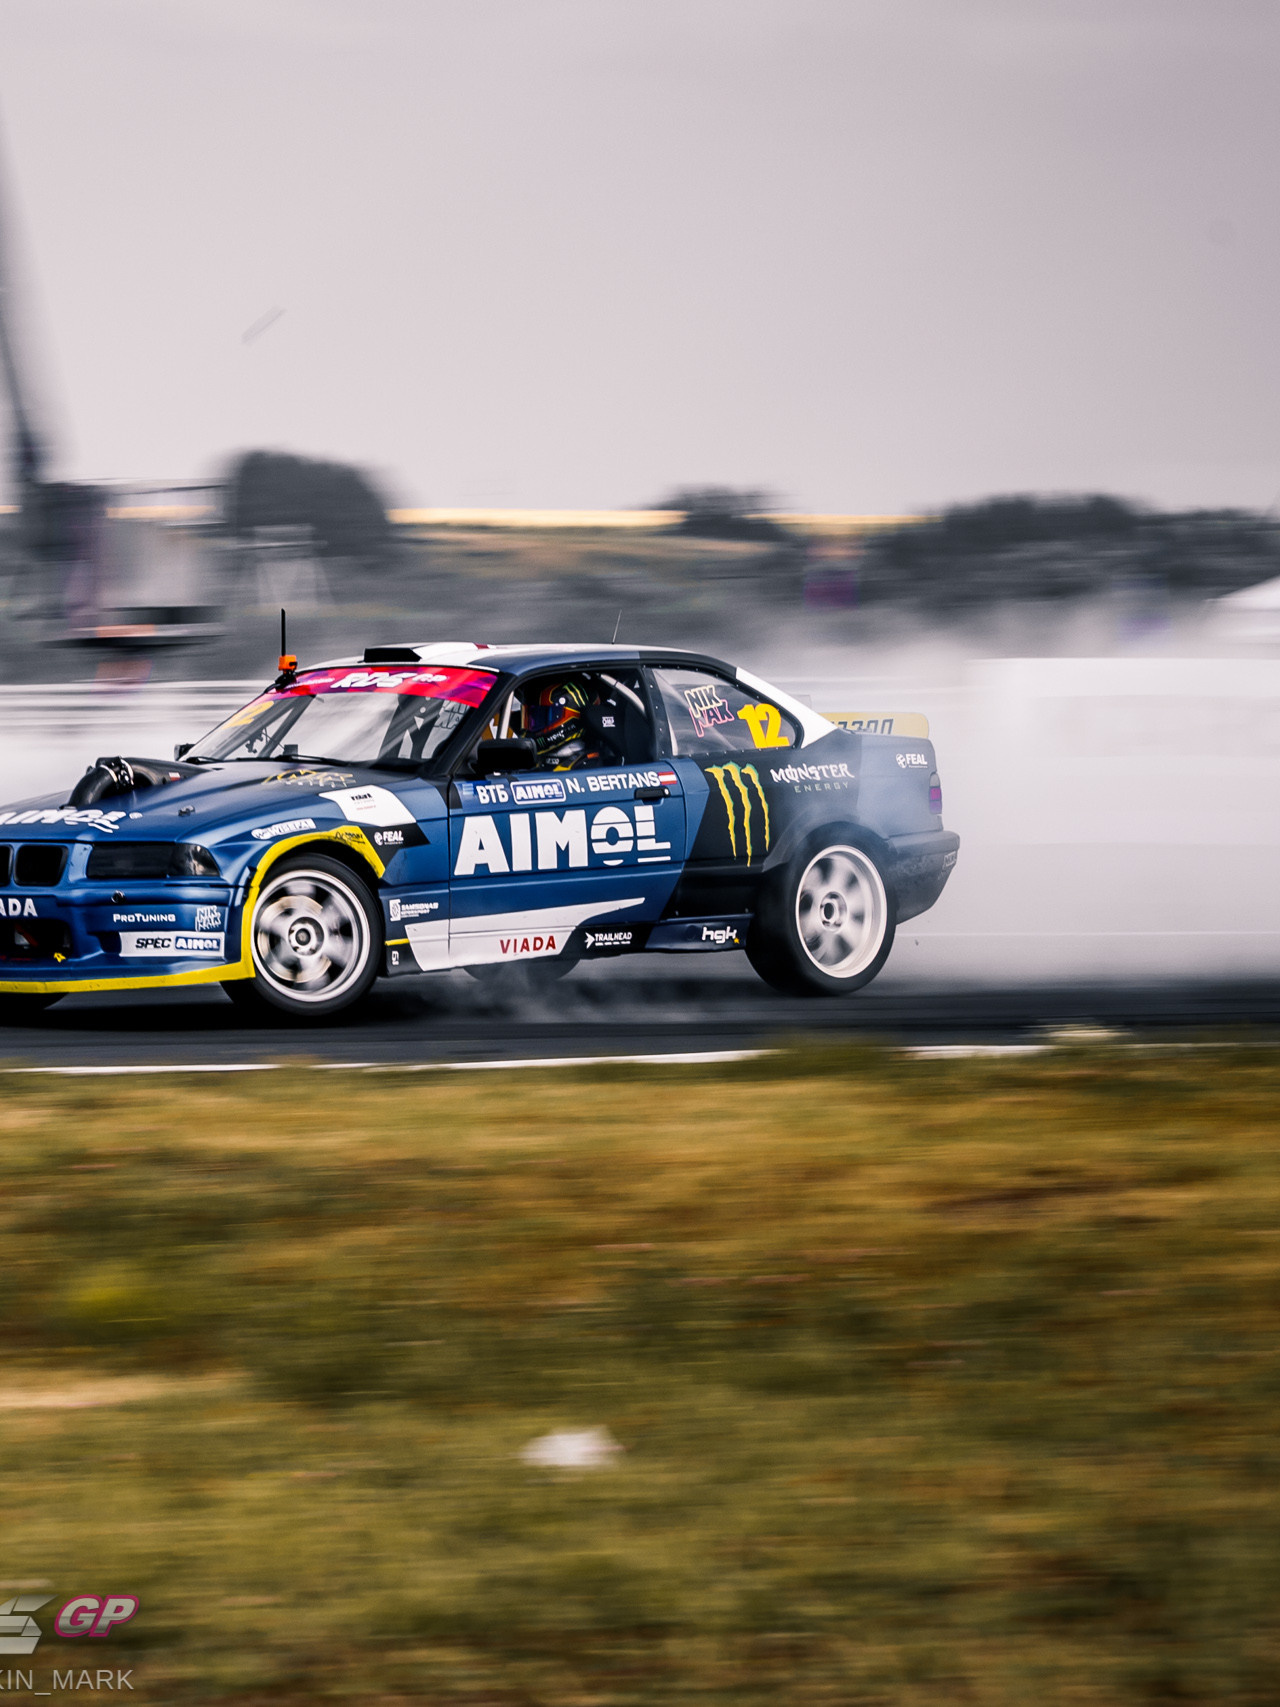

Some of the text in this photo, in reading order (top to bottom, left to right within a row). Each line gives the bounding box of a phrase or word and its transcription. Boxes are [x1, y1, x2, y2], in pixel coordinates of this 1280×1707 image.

[330, 672, 418, 688] RDS
[684, 685, 723, 718] NIK
[689, 699, 734, 737] NAK
[737, 703, 790, 749] 12
[905, 753, 928, 765] FEAL
[770, 762, 855, 784] MONSTER
[566, 771, 661, 794] N. BERTANS
[794, 781, 849, 793] ENERGY
[476, 784, 509, 804] ВТБ
[515, 784, 565, 801] AIMOL
[382, 830, 404, 842] FEAL
[453, 805, 671, 876] AIMOL
[135, 937, 219, 951] SPEC AIMOL
[594, 932, 632, 941] TRAILHEAD
[701, 926, 737, 944] hgk
[499, 935, 556, 954] VIADA
